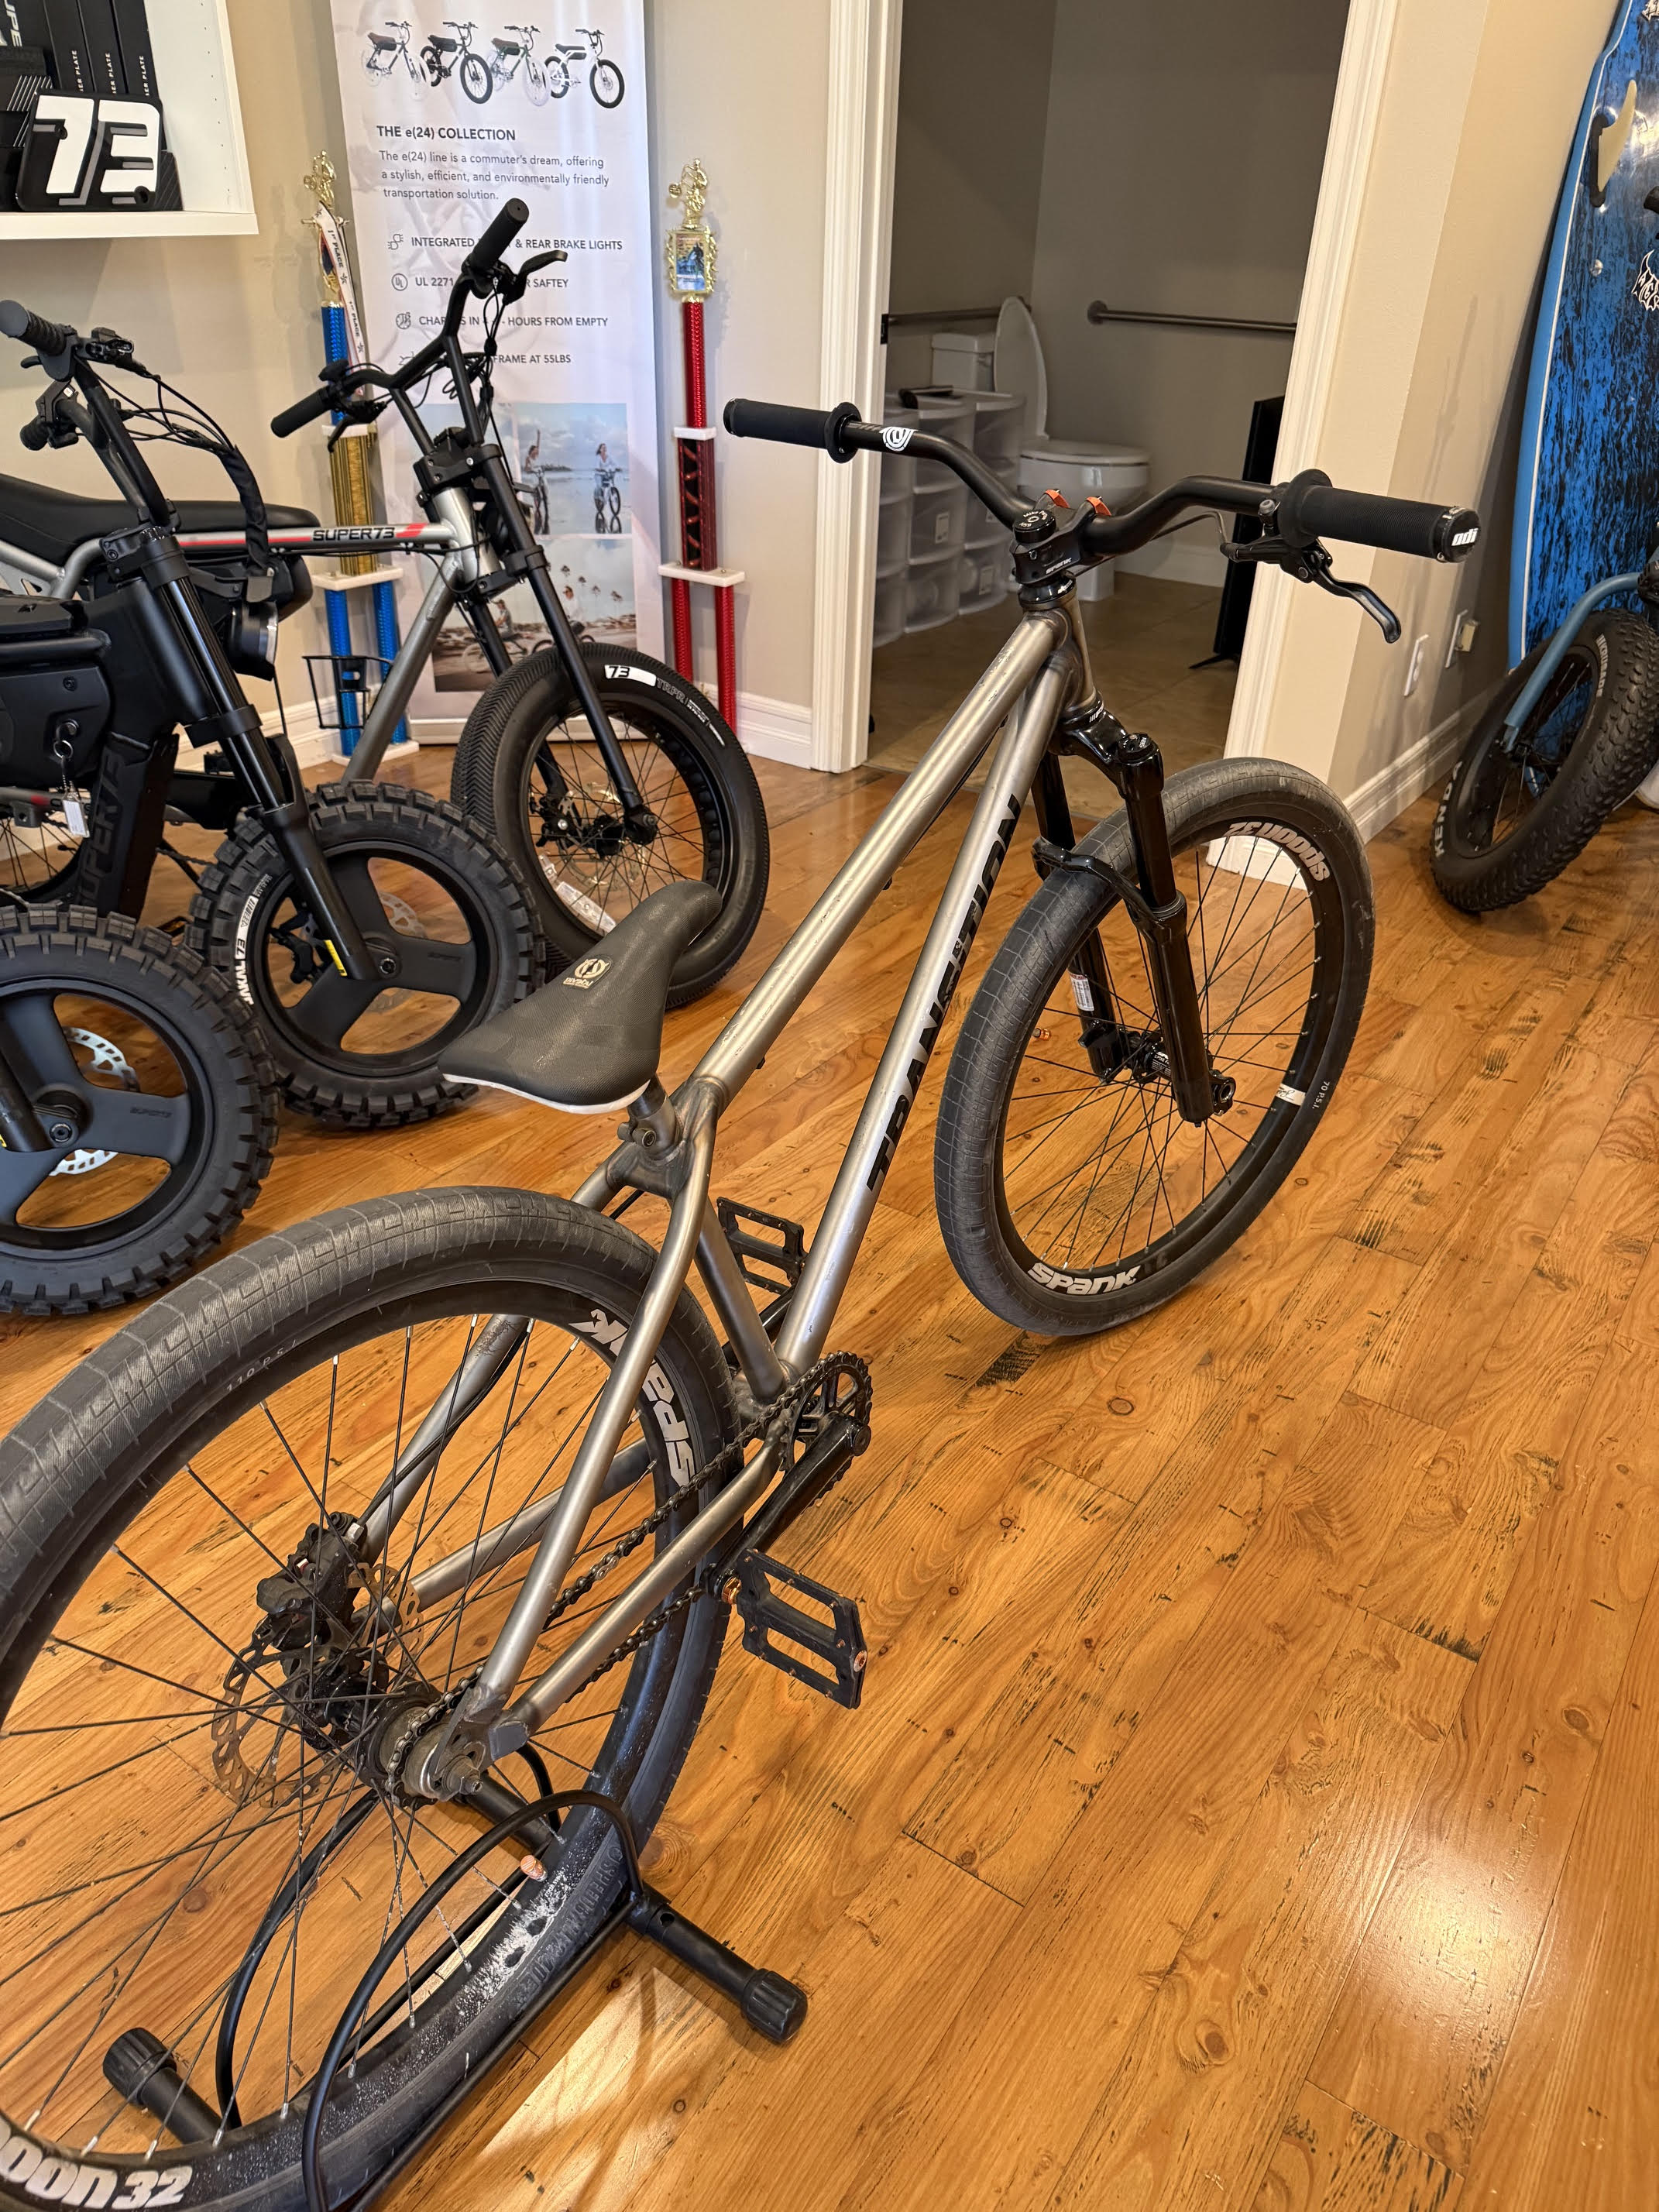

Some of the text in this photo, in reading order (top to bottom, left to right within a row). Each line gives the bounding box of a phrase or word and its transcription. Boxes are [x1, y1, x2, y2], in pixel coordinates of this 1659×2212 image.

[71, 50, 81, 75] PLATE
[105, 53, 114, 78] PLATE
[139, 55, 148, 80] PLATE
[376, 125, 516, 141] THE e(24) COLLECTION
[35, 94, 160, 194] 73
[379, 150, 399, 161] The
[402, 151, 427, 163] e(24)
[429, 152, 448, 162] line
[450, 153, 459, 162] is
[469, 154, 527, 165] commuter's
[530, 155, 564, 167] dream,
[566, 156, 604, 169] offering
[390, 168, 424, 181] stylish,
[428, 170, 469, 182] efficient,
[472, 171, 491, 182] and
[494, 173, 570, 187] environmentally
[573, 173, 610, 187] friendly
[383, 188, 500, 200] transportation solution.
[411, 237, 475, 247] INTEGRATED
[515, 239, 523, 249] &
[525, 239, 551, 249] REAR
[553, 240, 586, 249] BRAKE
[589, 240, 623, 250] LIGHTS
[332, 242, 345, 269] PLACE
[415, 278, 428, 287] UL
[431, 277, 454, 287] 2271
[533, 279, 568, 287] SAFTEY
[469, 317, 479, 325] IN
[508, 318, 542, 326] HOURS
[544, 318, 573, 326] FROM
[575, 318, 608, 326] EMPTY
[544, 355, 572, 363] 55LBS
[313, 527, 395, 541] SUPER73
[1451, 527, 1479, 547] odi
[609, 665, 630, 678] 73
[237, 938, 246, 956] 73
[1321, 1080, 1331, 1091] 70
